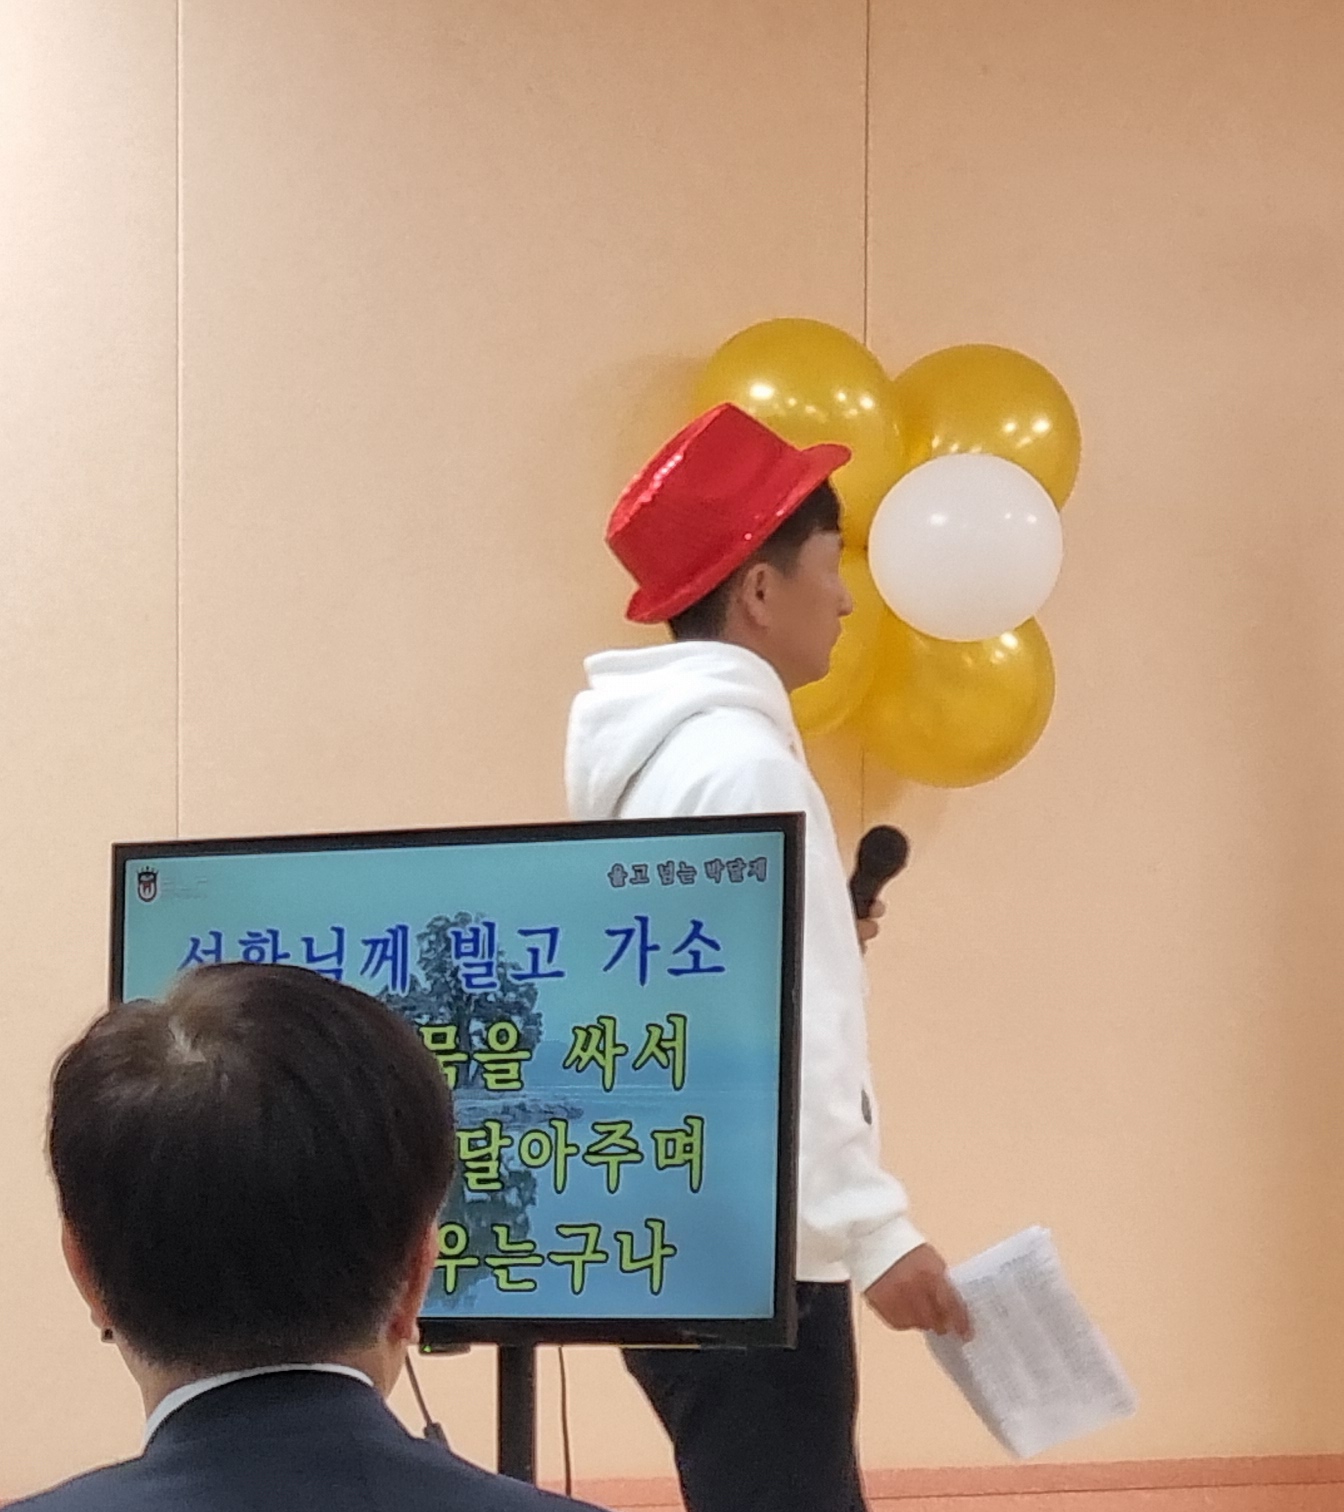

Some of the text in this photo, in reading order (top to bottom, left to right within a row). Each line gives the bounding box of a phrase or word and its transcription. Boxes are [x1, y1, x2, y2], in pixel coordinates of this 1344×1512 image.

[704, 857, 768, 883] 박달재
[446, 921, 566, 991] 빌고
[602, 915, 727, 986] 가소
[562, 1013, 688, 1092] 싸서
[455, 1115, 705, 1195] 달아주며
[434, 1217, 678, 1295] 우는구나
